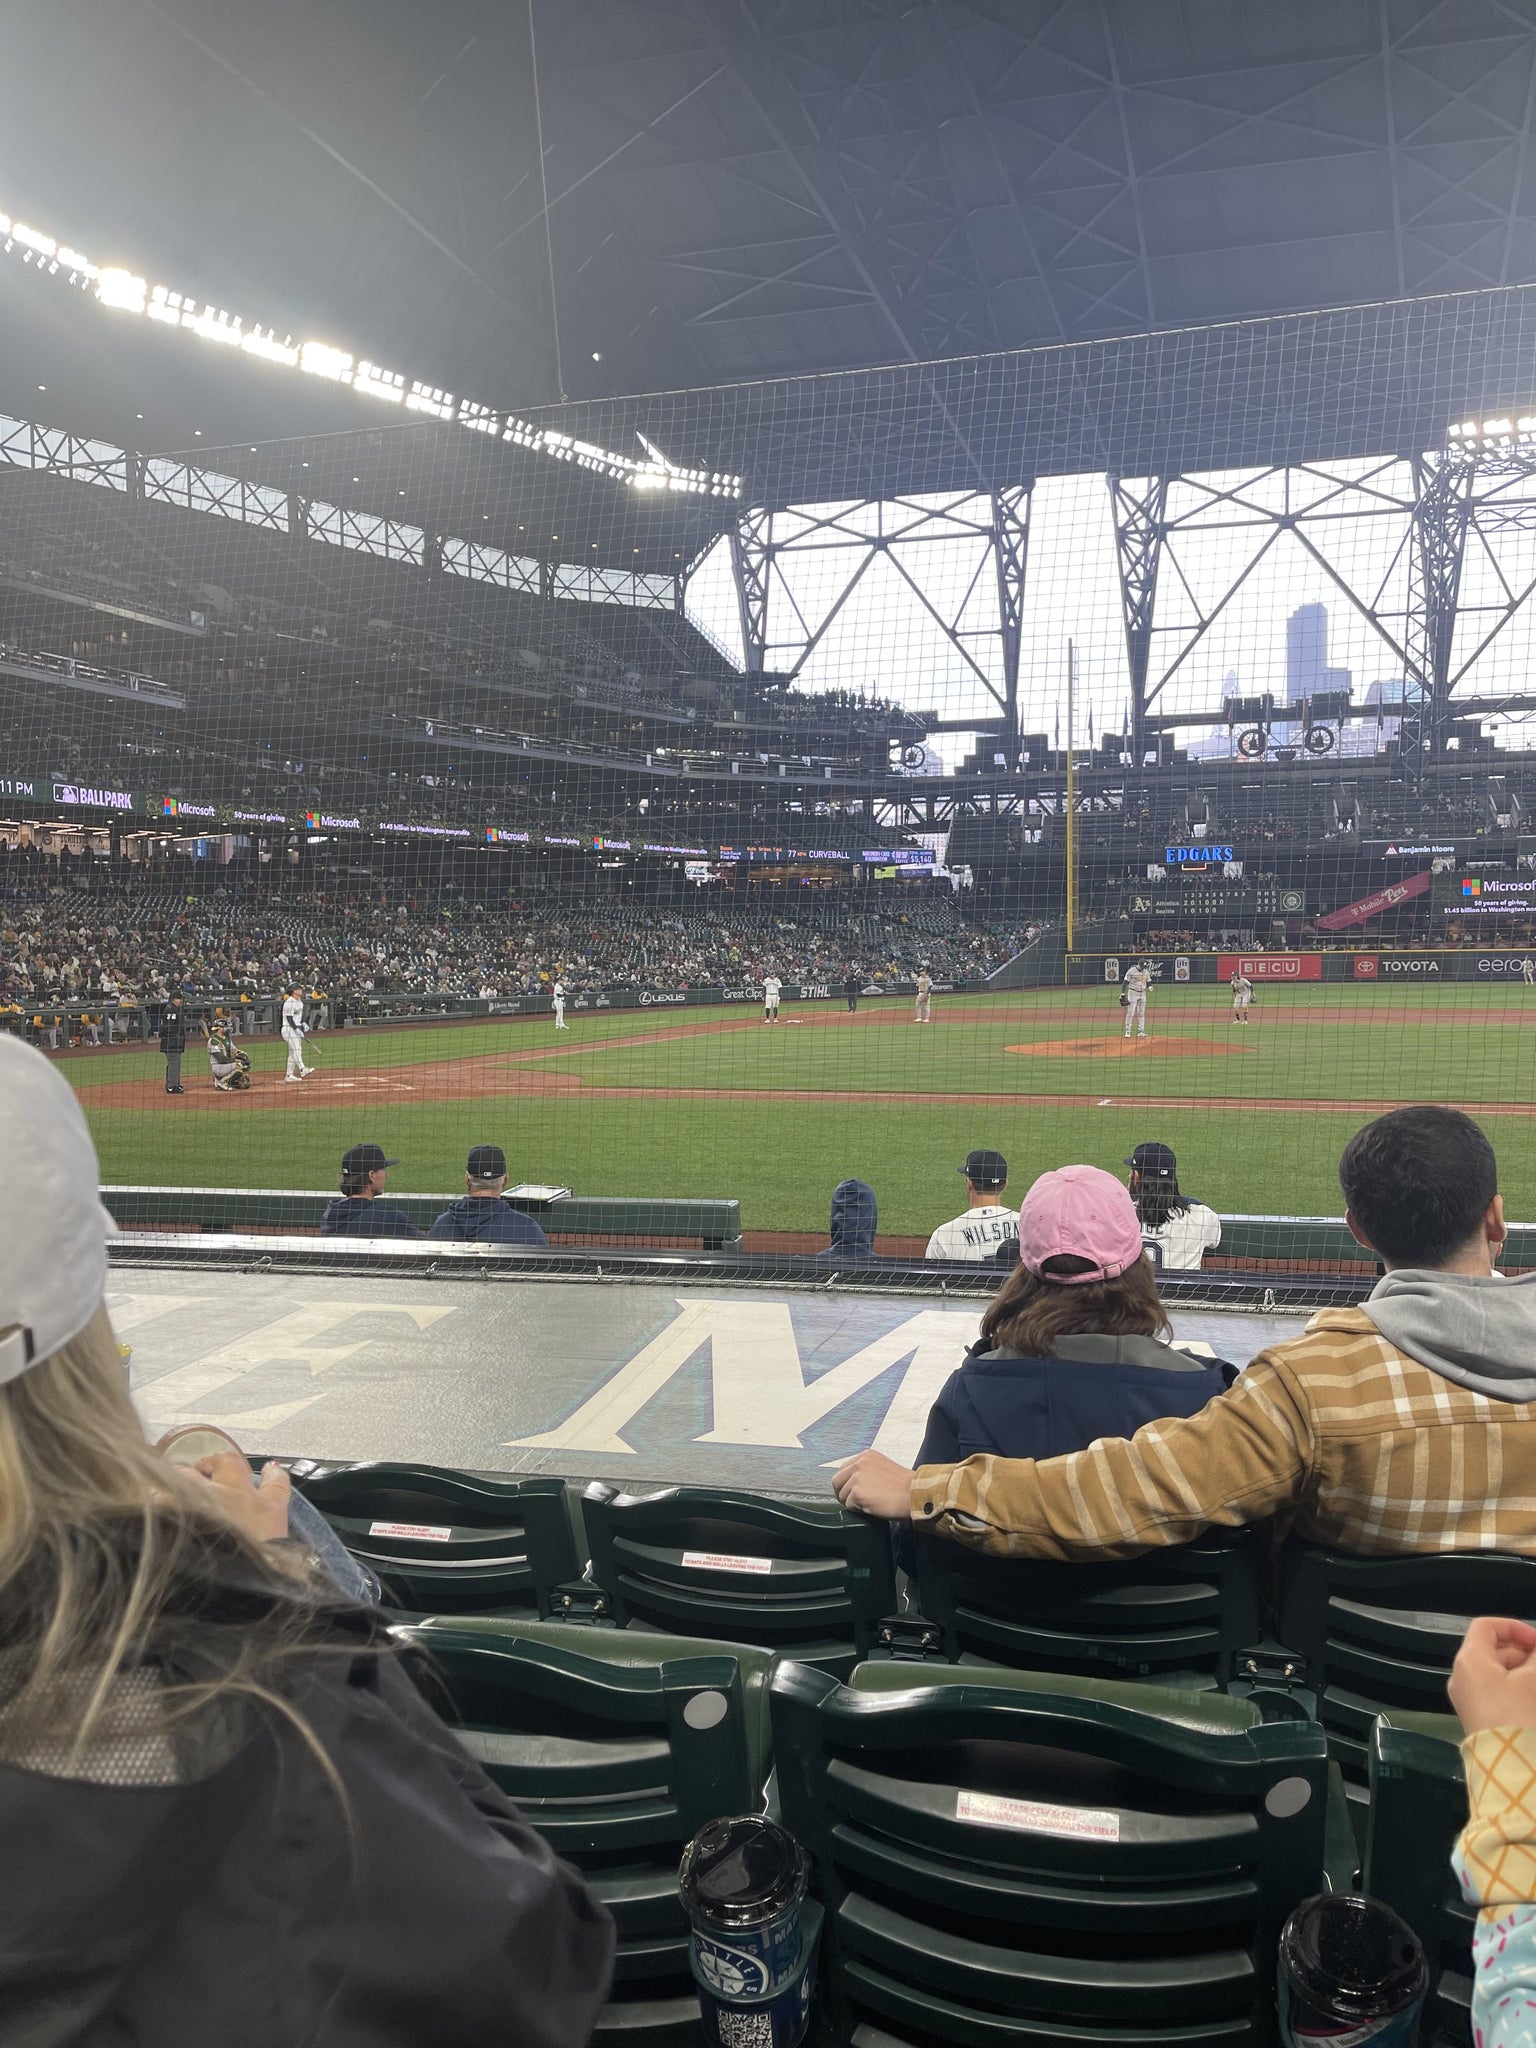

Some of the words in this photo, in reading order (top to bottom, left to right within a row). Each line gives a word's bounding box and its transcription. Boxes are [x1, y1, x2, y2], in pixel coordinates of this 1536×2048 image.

[16, 782, 33, 796] PM
[80, 788, 132, 809] BALLPARK
[178, 802, 215, 816] Microsoft
[243, 812, 258, 820] years
[321, 816, 360, 828] Microsoft
[498, 830, 529, 842] Microsoft
[604, 840, 631, 850] Microsoft
[1398, 846, 1430, 854] Benjamin
[809, 850, 850, 859] CURVEBALL
[1244, 963, 1295, 972] BECU
[1383, 961, 1439, 972] TOYOTA
[1478, 959, 1523, 972] eero
[723, 989, 744, 999] Great
[745, 988, 762, 1000] Clips
[800, 985, 830, 998] STIHL
